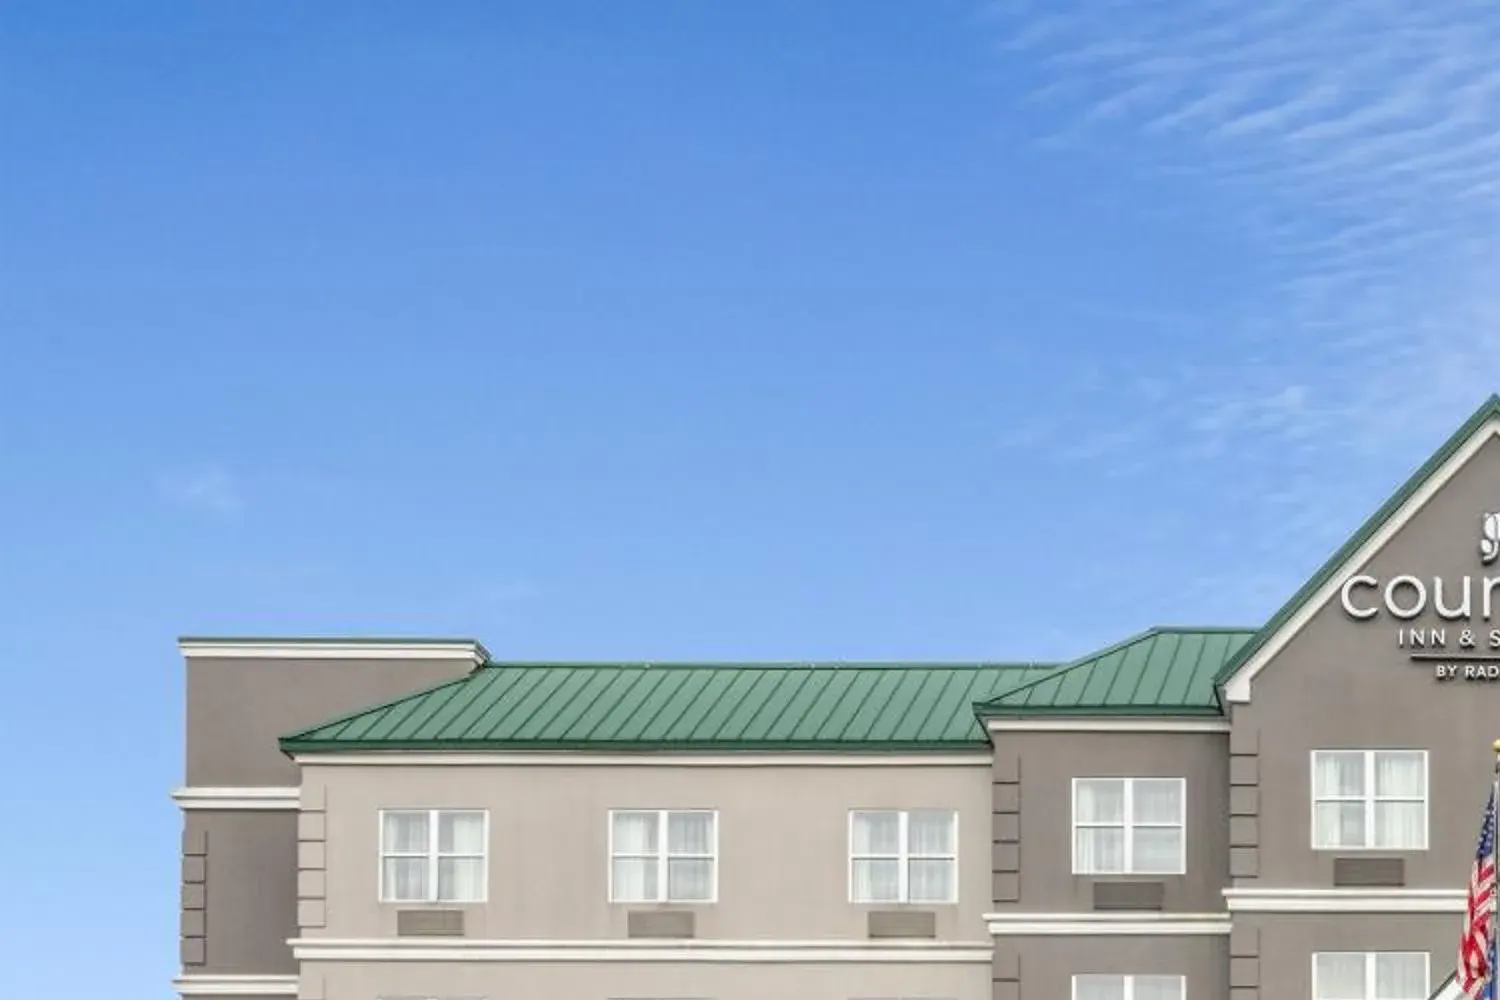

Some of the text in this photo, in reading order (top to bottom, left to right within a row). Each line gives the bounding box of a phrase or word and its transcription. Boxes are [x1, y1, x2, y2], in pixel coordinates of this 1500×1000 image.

[1399, 628, 1445, 646] INN
[1459, 628, 1475, 647] &
[1436, 664, 1457, 678] BY
